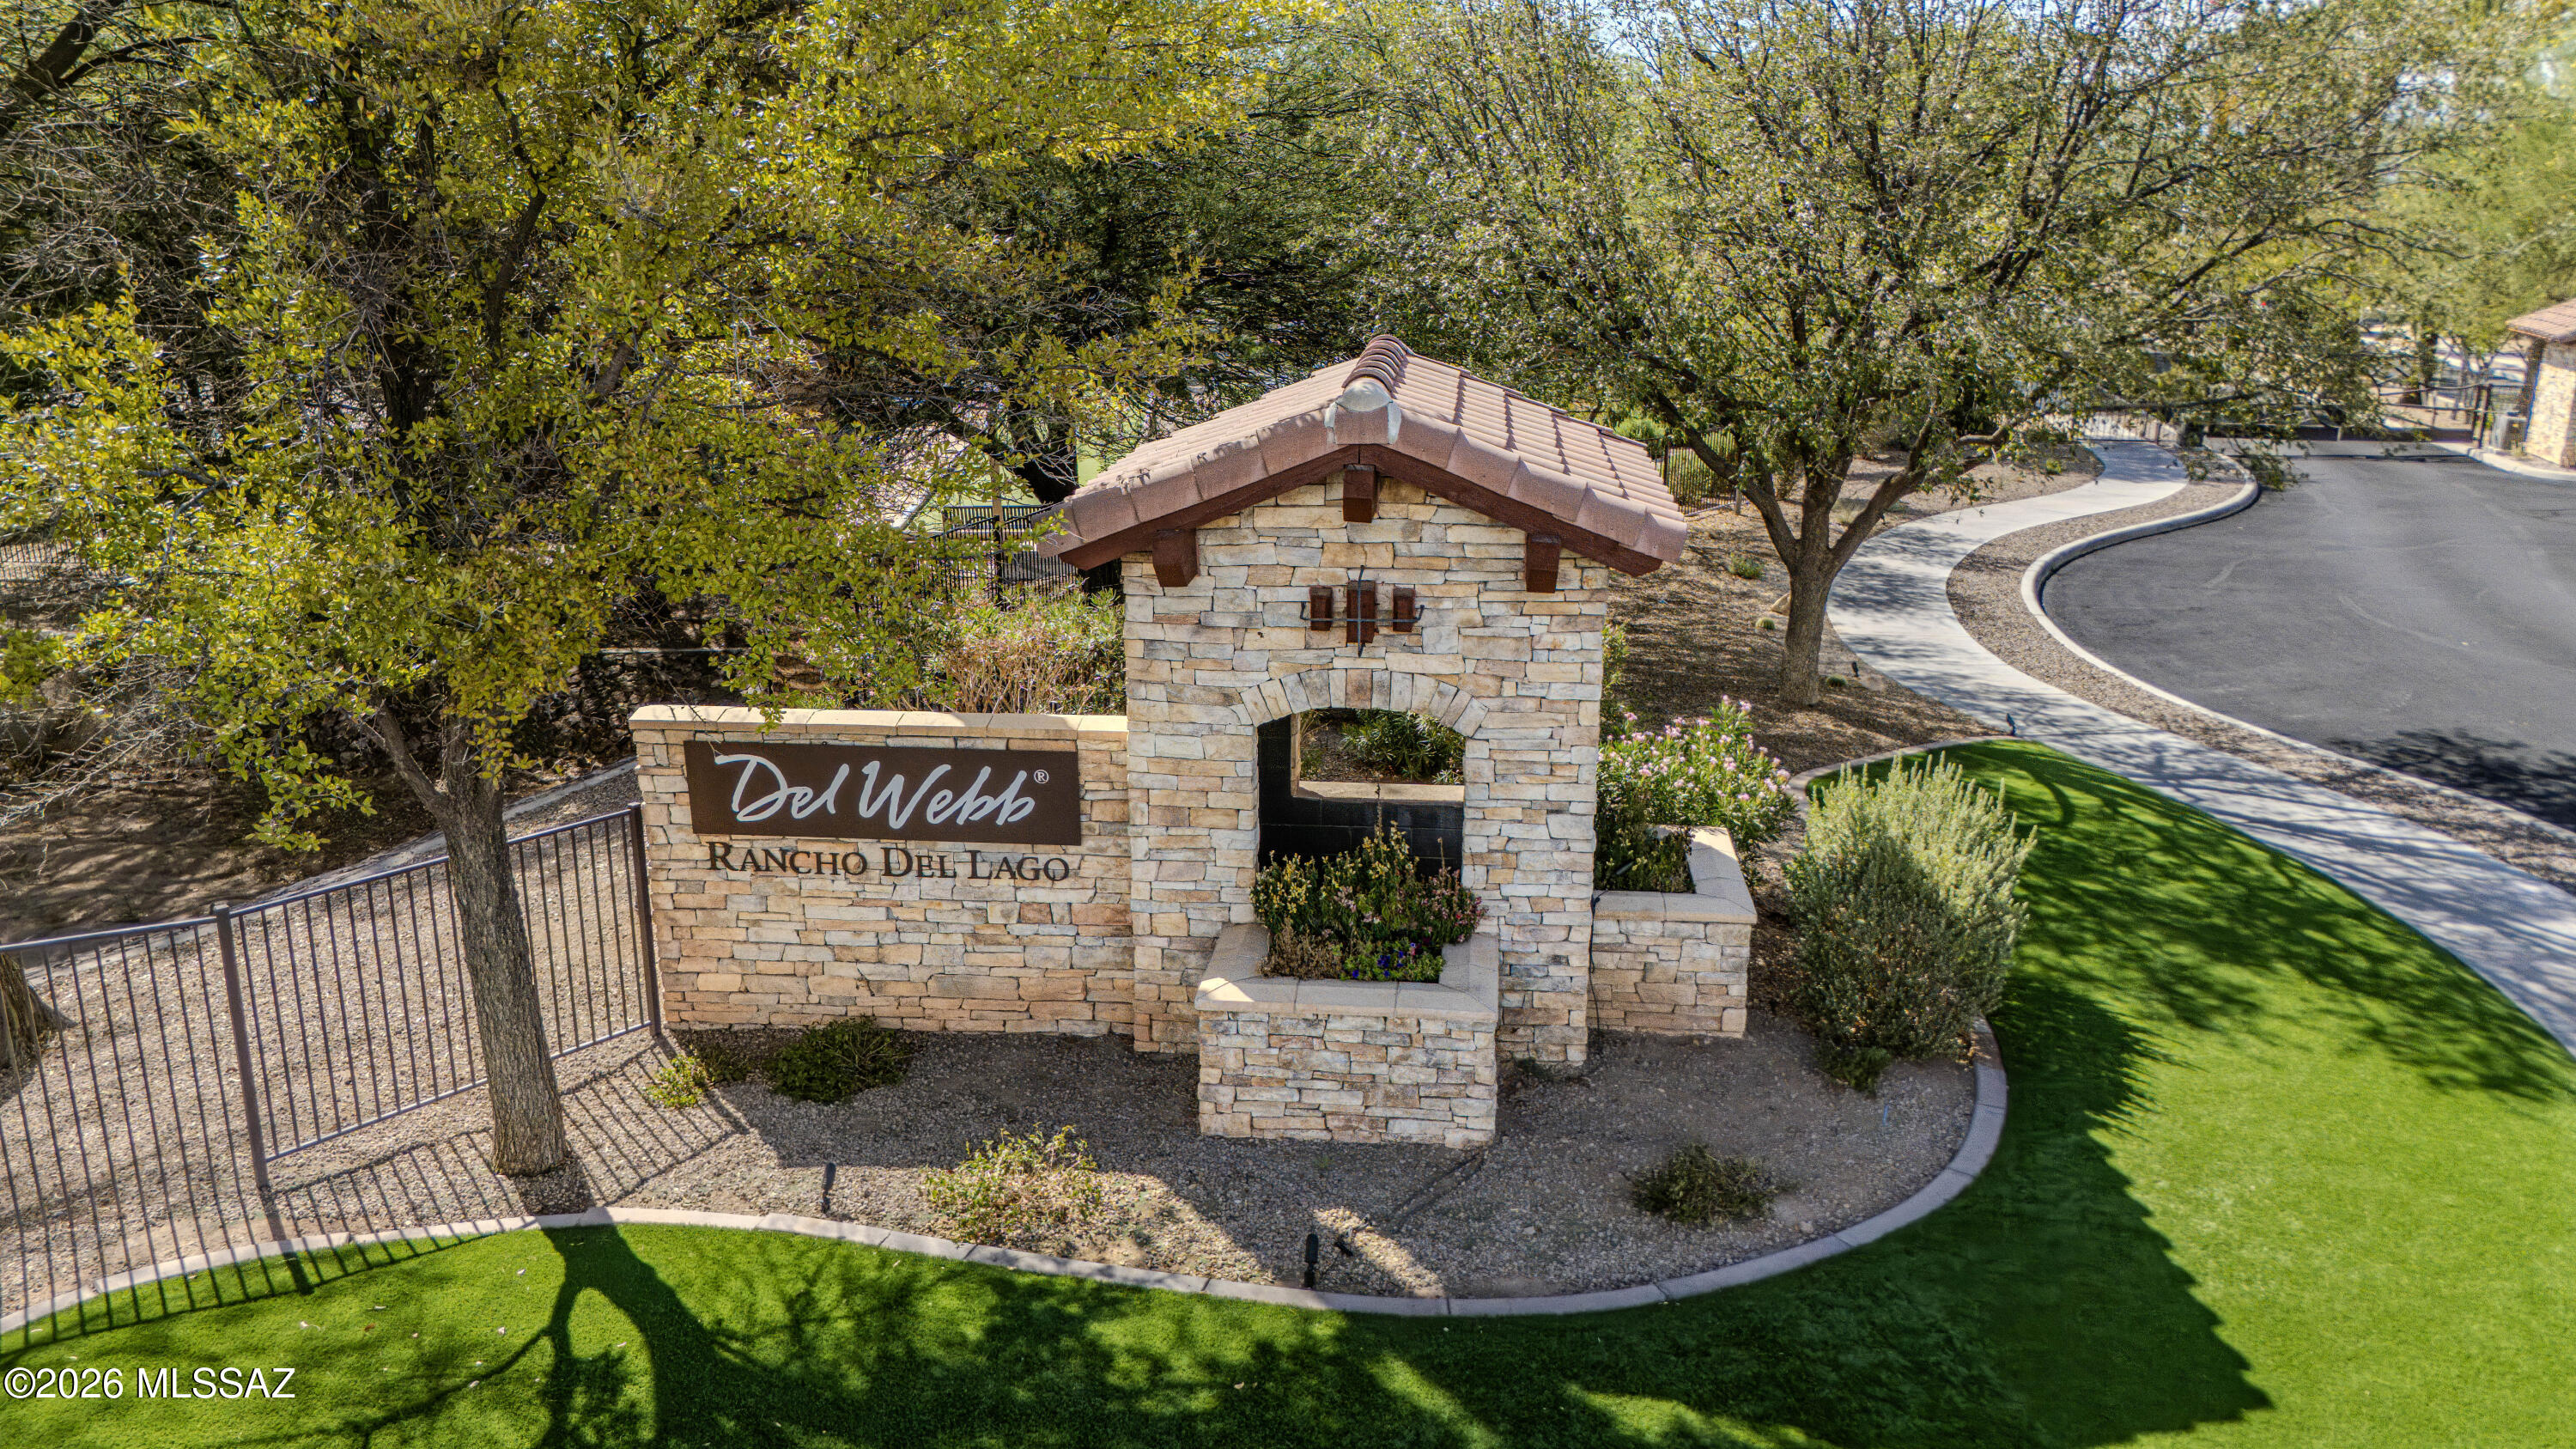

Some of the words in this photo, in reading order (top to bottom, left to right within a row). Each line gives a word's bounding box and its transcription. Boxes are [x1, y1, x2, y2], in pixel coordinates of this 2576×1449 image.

[714, 753, 850, 822] Del
[706, 841, 868, 876] RANCHO
[880, 847, 957, 879] DEL
[967, 849, 1070, 882] LAGO
